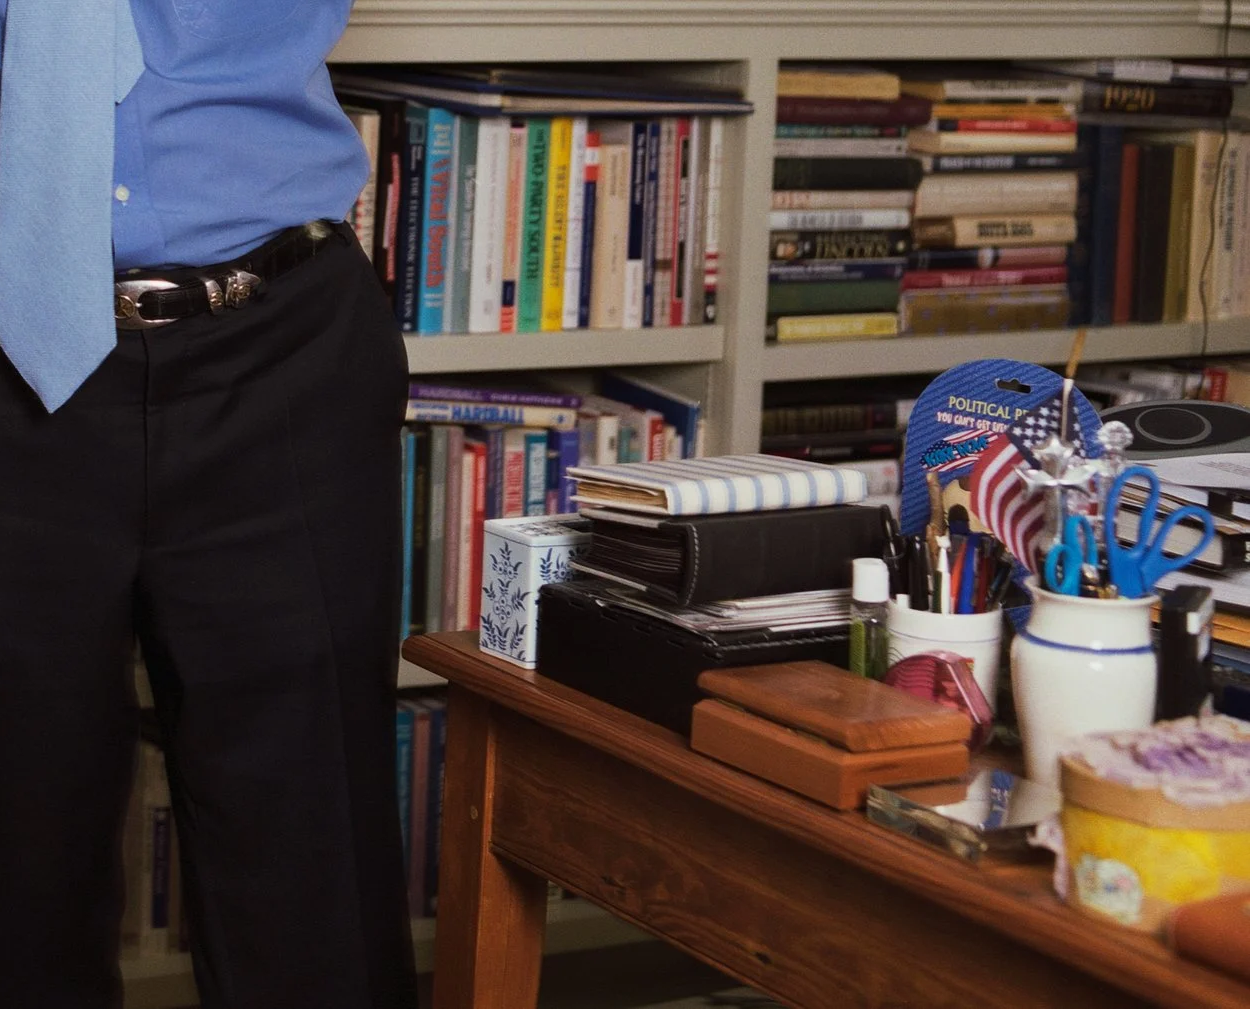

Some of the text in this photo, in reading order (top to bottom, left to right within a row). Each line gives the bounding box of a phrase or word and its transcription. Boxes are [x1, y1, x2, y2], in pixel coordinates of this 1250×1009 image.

[425, 173, 450, 288] Vital South
[451, 406, 524, 424] HARDBALL
[949, 396, 1011, 420] POLITICAL
[937, 412, 952, 423] YOU
[954, 416, 976, 427] CAN'T
[977, 420, 991, 431] GET
